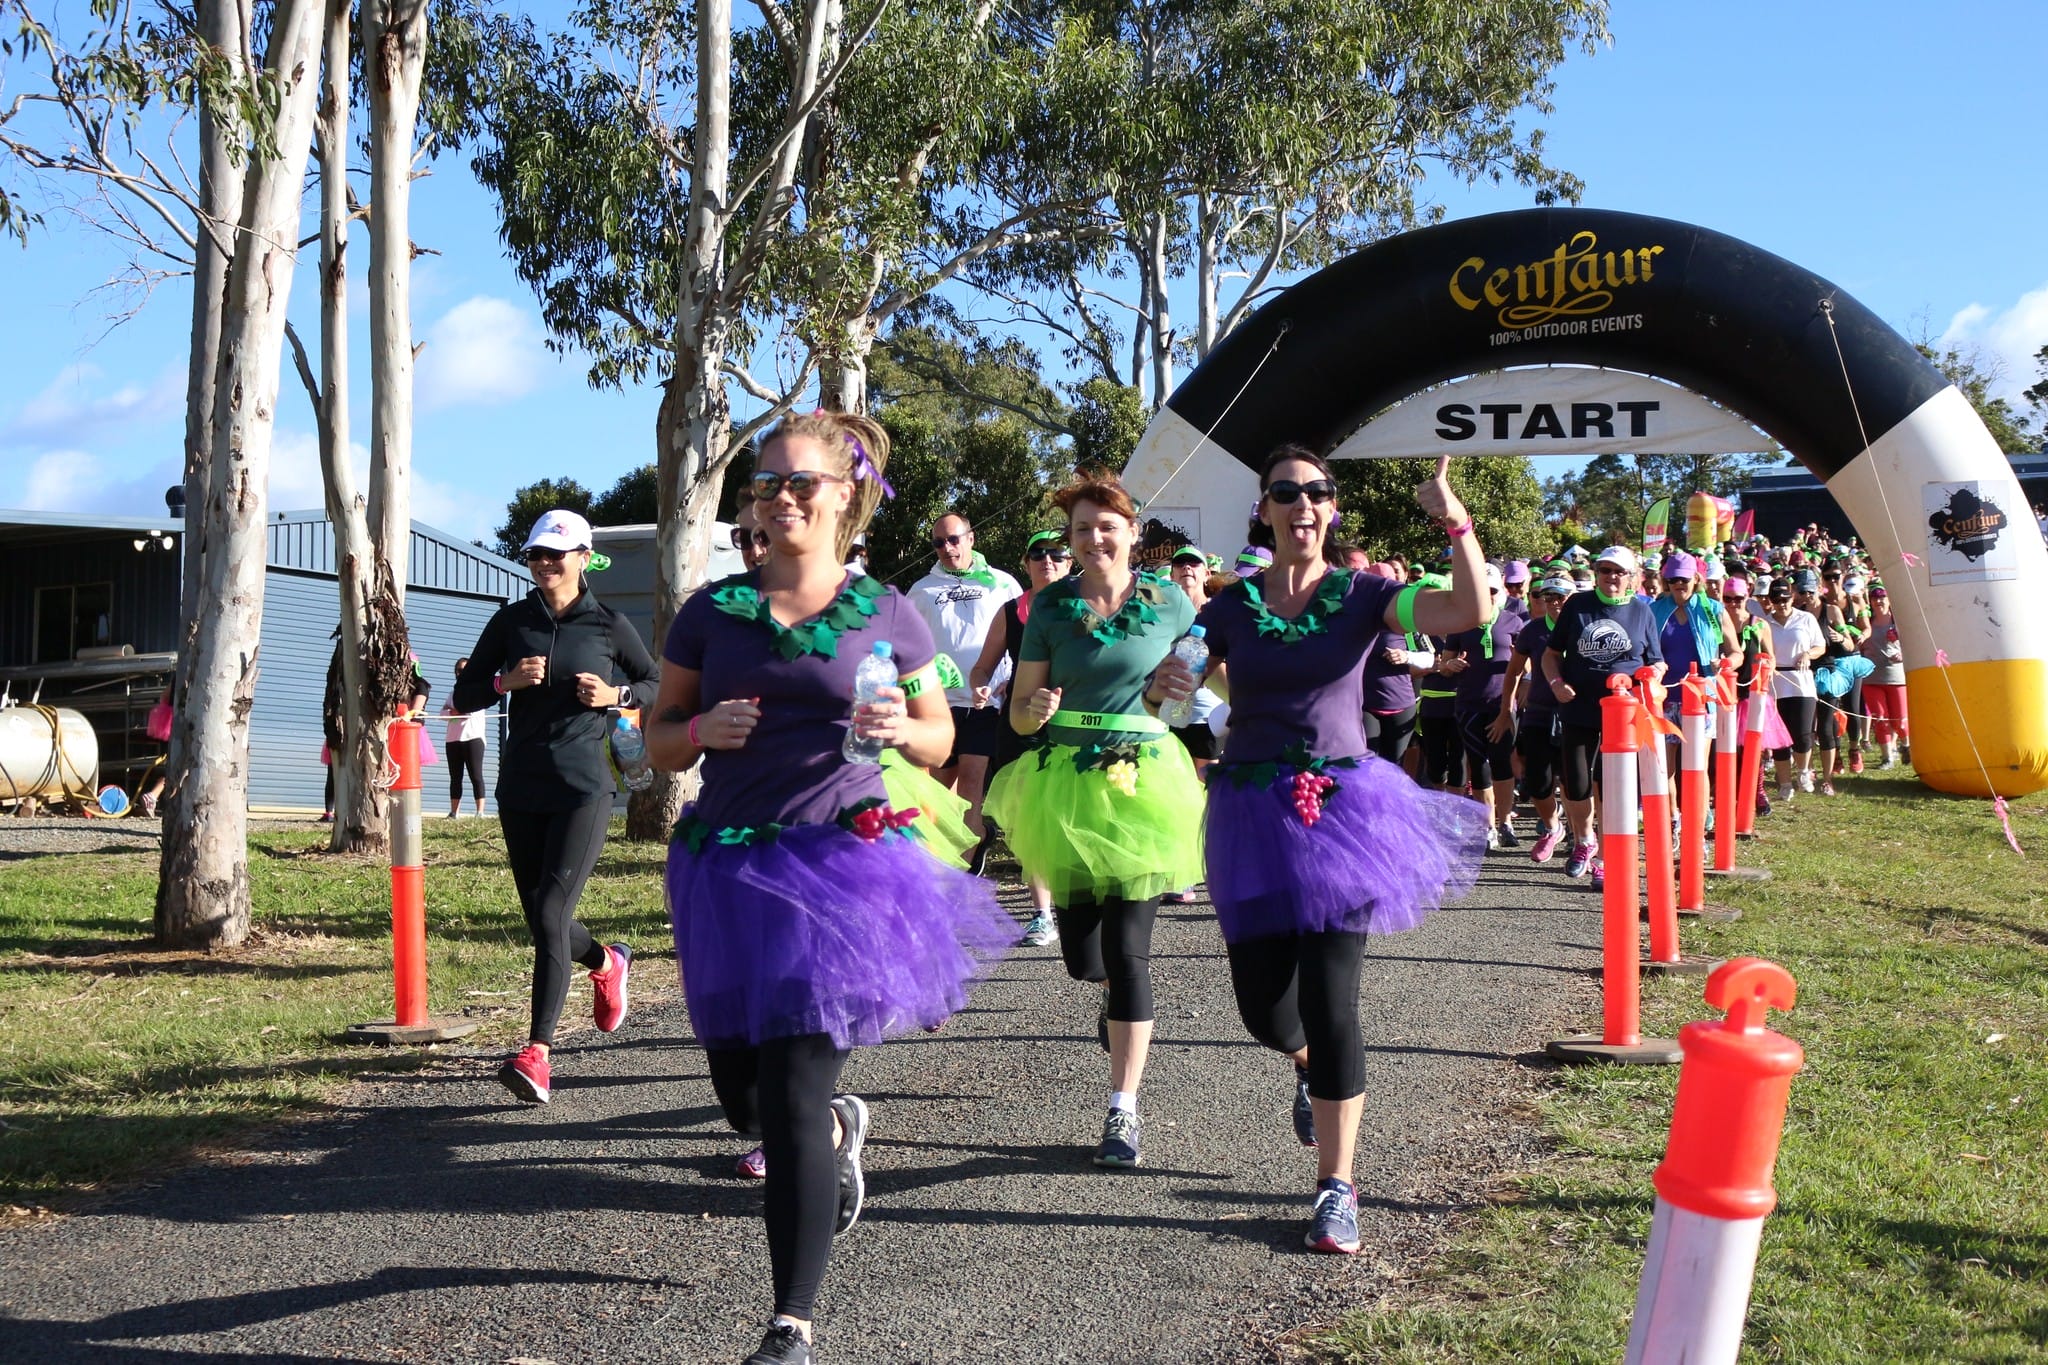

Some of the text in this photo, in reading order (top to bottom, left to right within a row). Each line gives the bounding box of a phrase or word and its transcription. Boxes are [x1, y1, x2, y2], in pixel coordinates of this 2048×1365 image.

[1449, 231, 1665, 329] Centaur
[1489, 313, 1643, 346] 100% OUTDOOR EVENTS
[1435, 401, 1660, 441] START
[1943, 509, 2001, 539] Centaur
[1577, 638, 1600, 652] Dam
[1081, 714, 1103, 726] 2017
